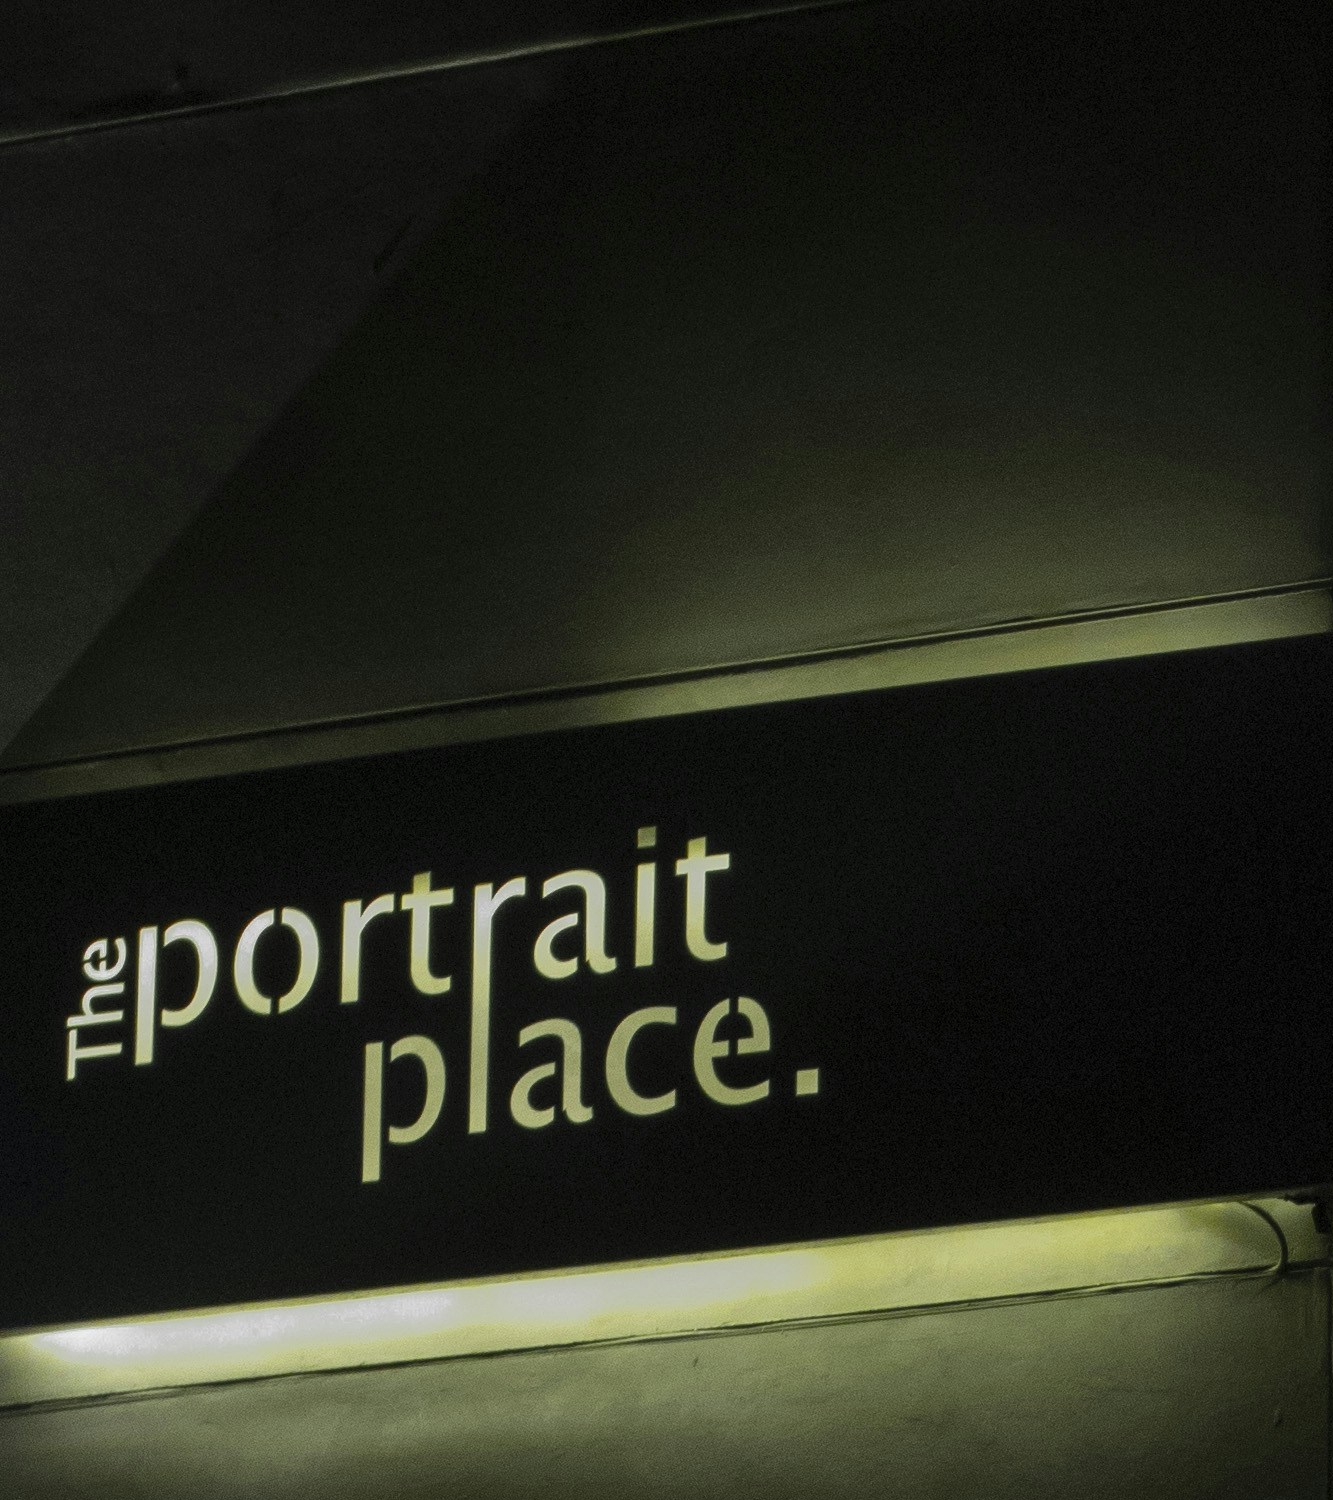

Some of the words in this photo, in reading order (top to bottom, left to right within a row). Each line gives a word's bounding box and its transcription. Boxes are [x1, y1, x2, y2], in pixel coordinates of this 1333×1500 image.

[66, 935, 128, 1081] The
[134, 826, 731, 1066] portrait
[361, 960, 821, 1183] place.
